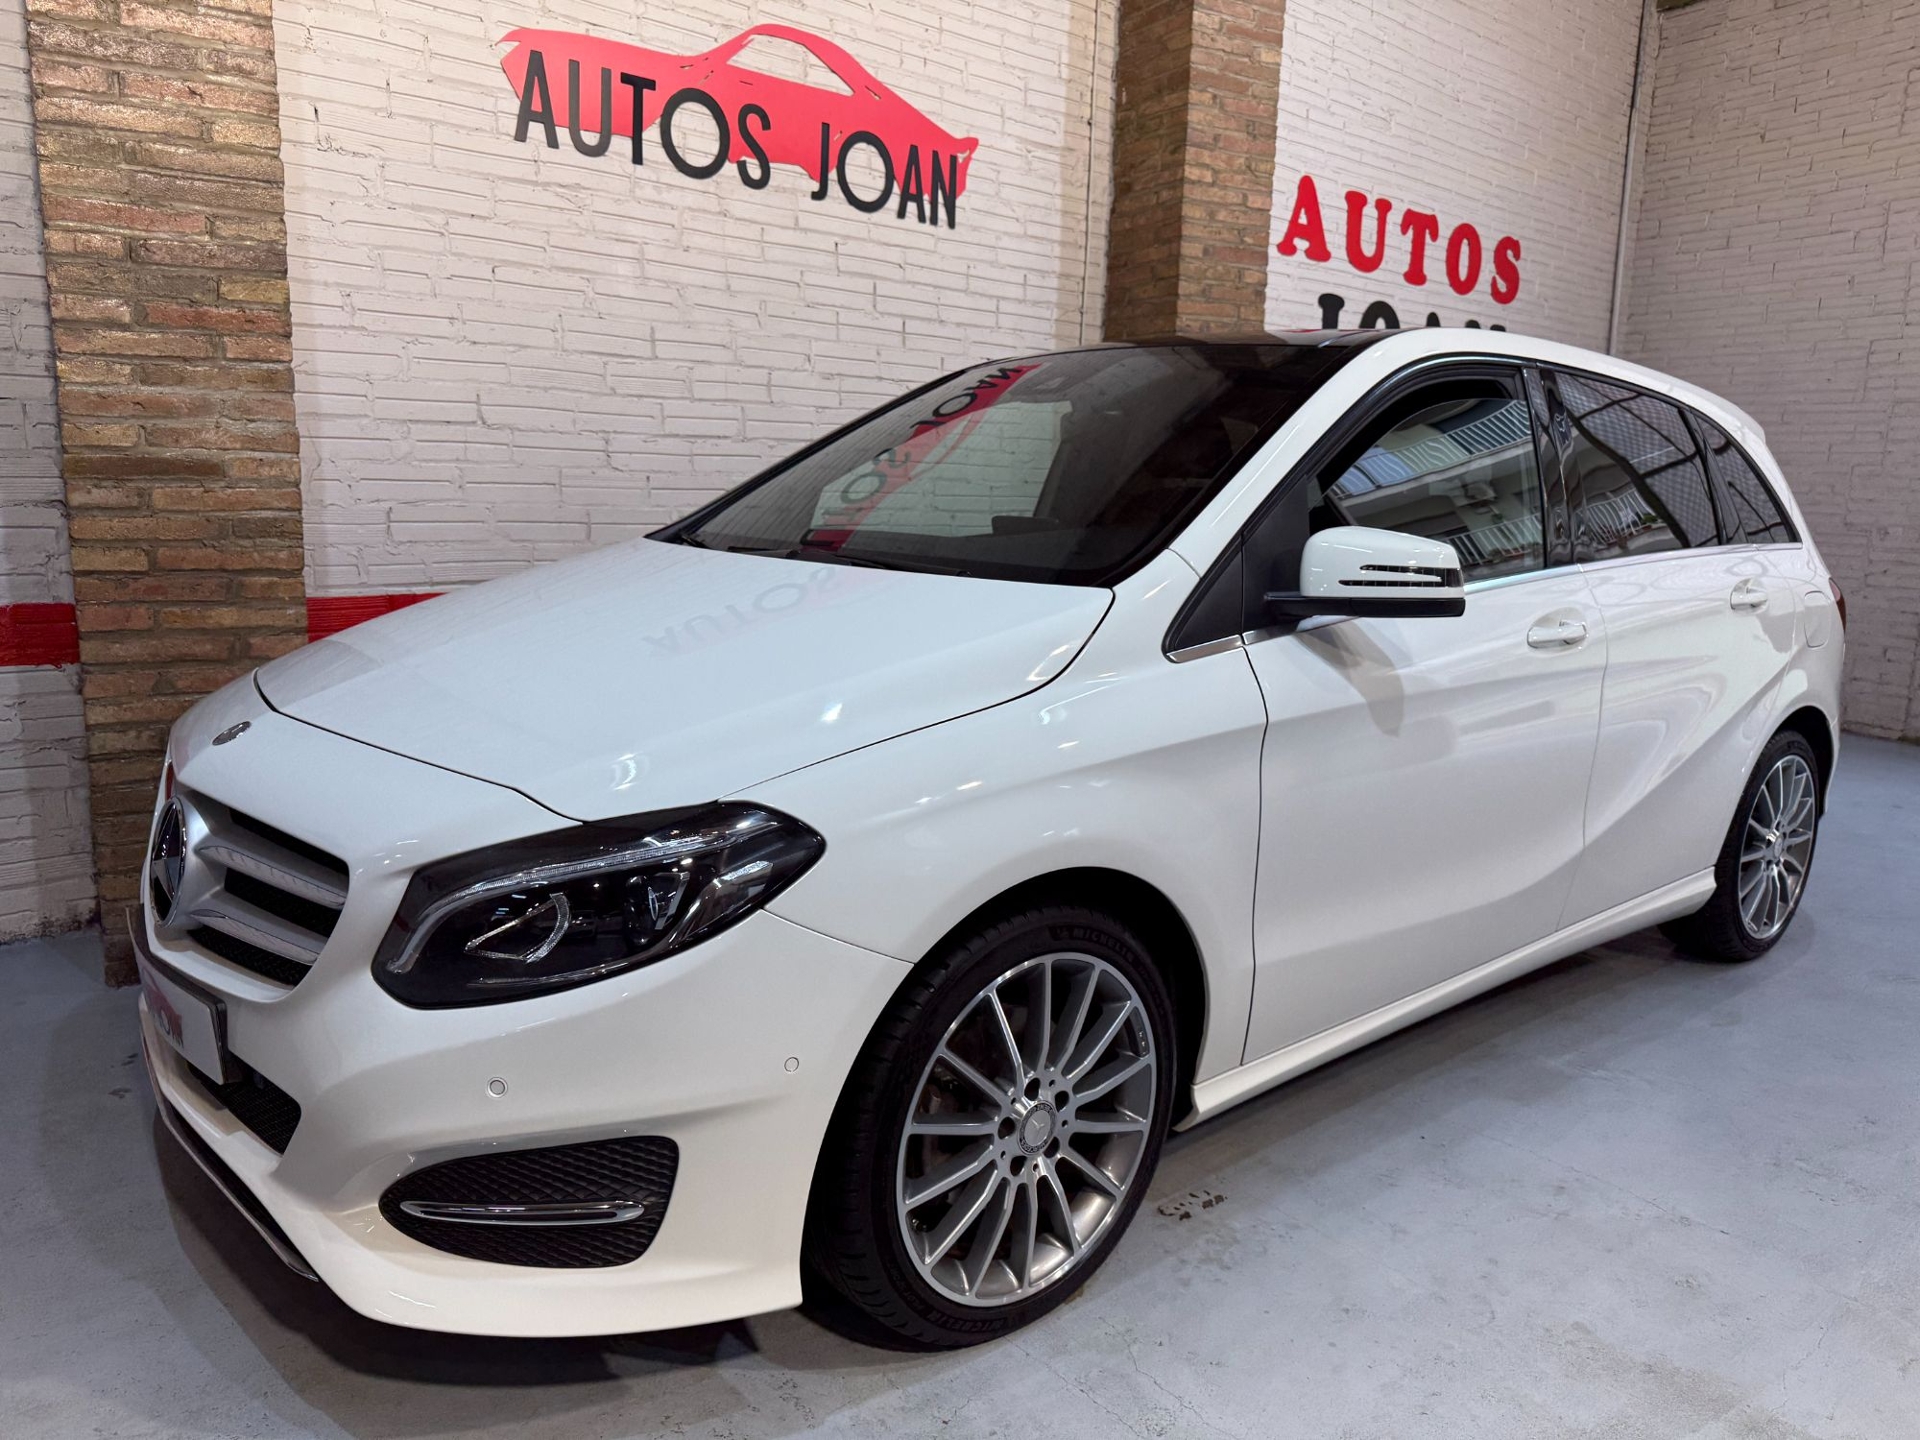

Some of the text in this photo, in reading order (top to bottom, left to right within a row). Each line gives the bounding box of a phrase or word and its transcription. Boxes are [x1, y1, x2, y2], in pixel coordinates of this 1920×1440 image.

[513, 49, 957, 229] AUTOS JOAN
[1276, 175, 1521, 305] AUTOS
